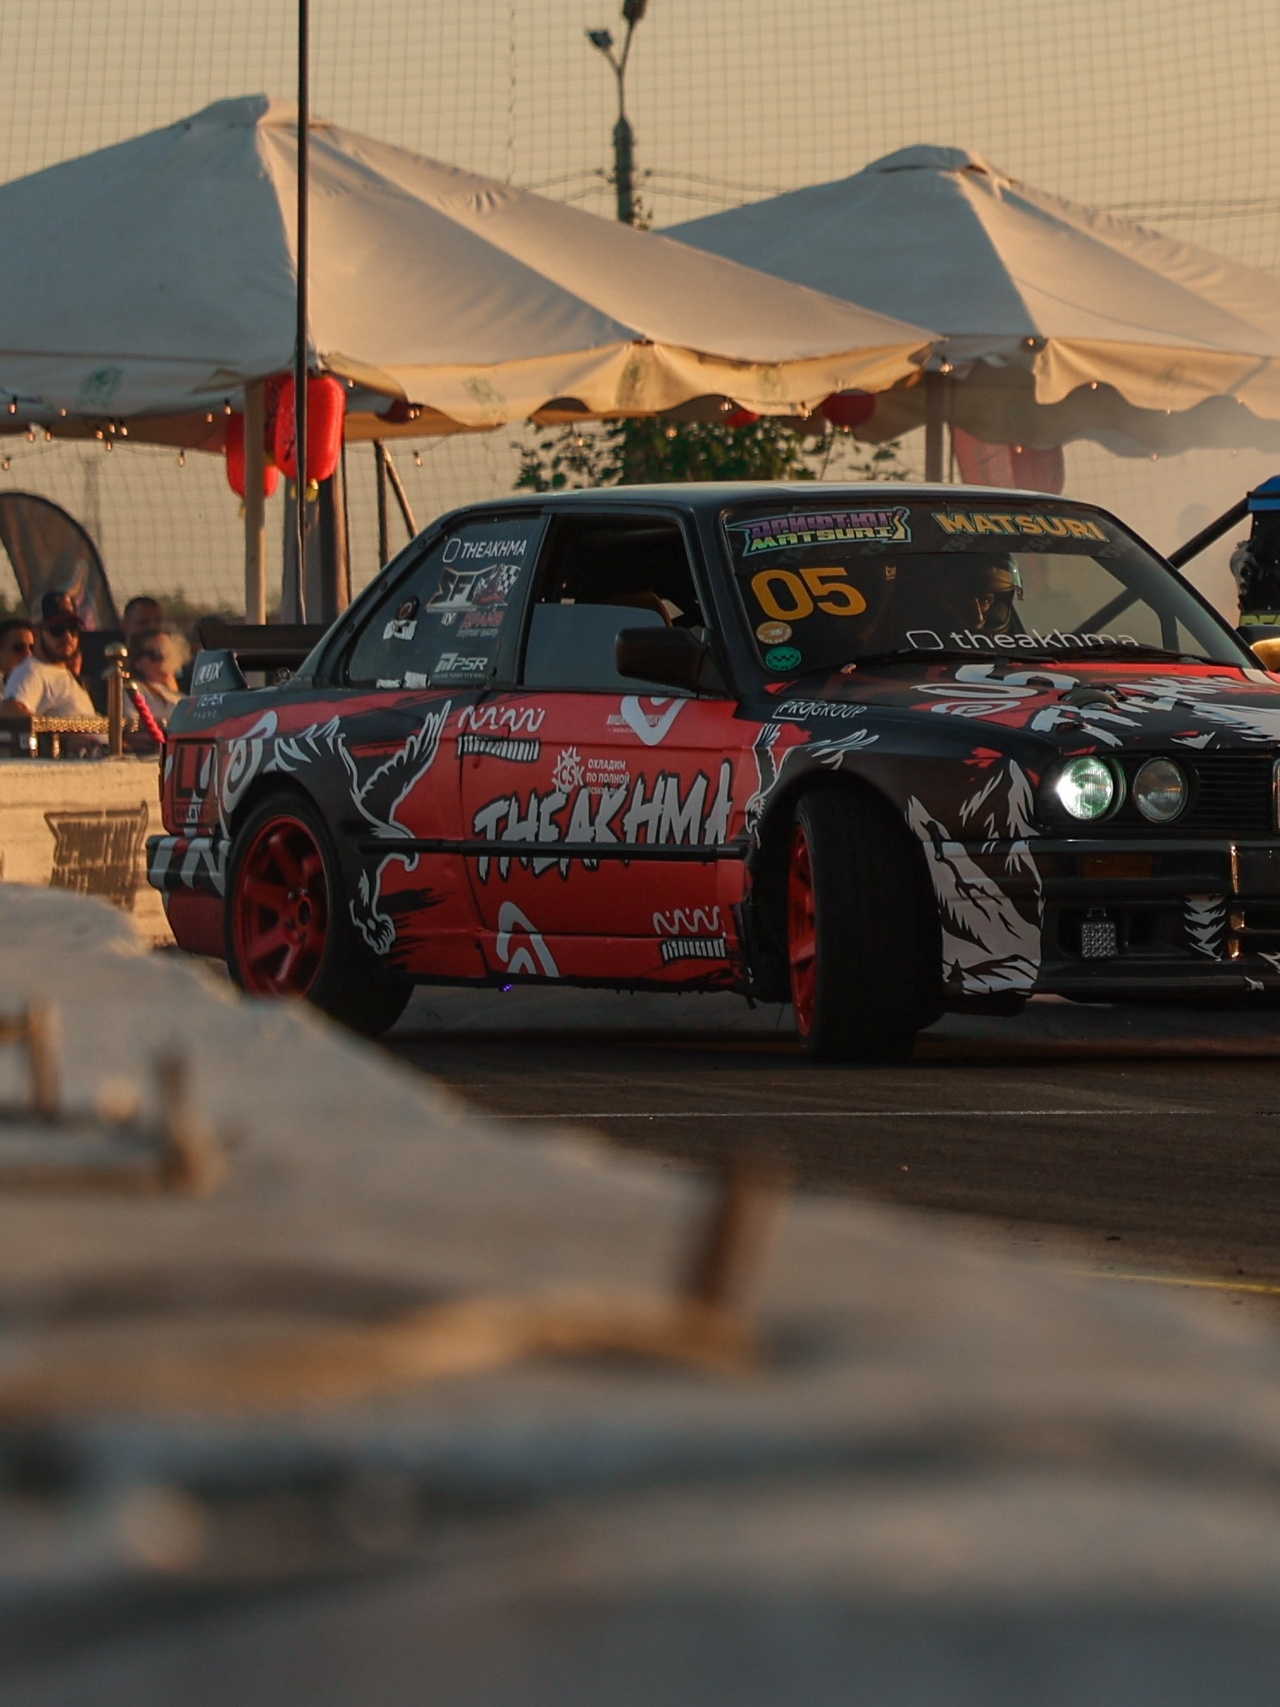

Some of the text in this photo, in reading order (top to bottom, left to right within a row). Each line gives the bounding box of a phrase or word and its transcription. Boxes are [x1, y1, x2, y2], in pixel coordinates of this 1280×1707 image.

[934, 512, 1109, 542] MATSURI
[750, 526, 893, 551] MATSURI
[461, 539, 527, 559] THEAKHMA
[751, 567, 867, 621] 05
[950, 629, 1139, 649] theakhma
[452, 657, 488, 671] PSR
[588, 759, 626, 771] ОХЛАДИМ
[586, 772, 630, 784] ПО ПОЛНОЙ
[474, 762, 733, 882] THEAKHMA
